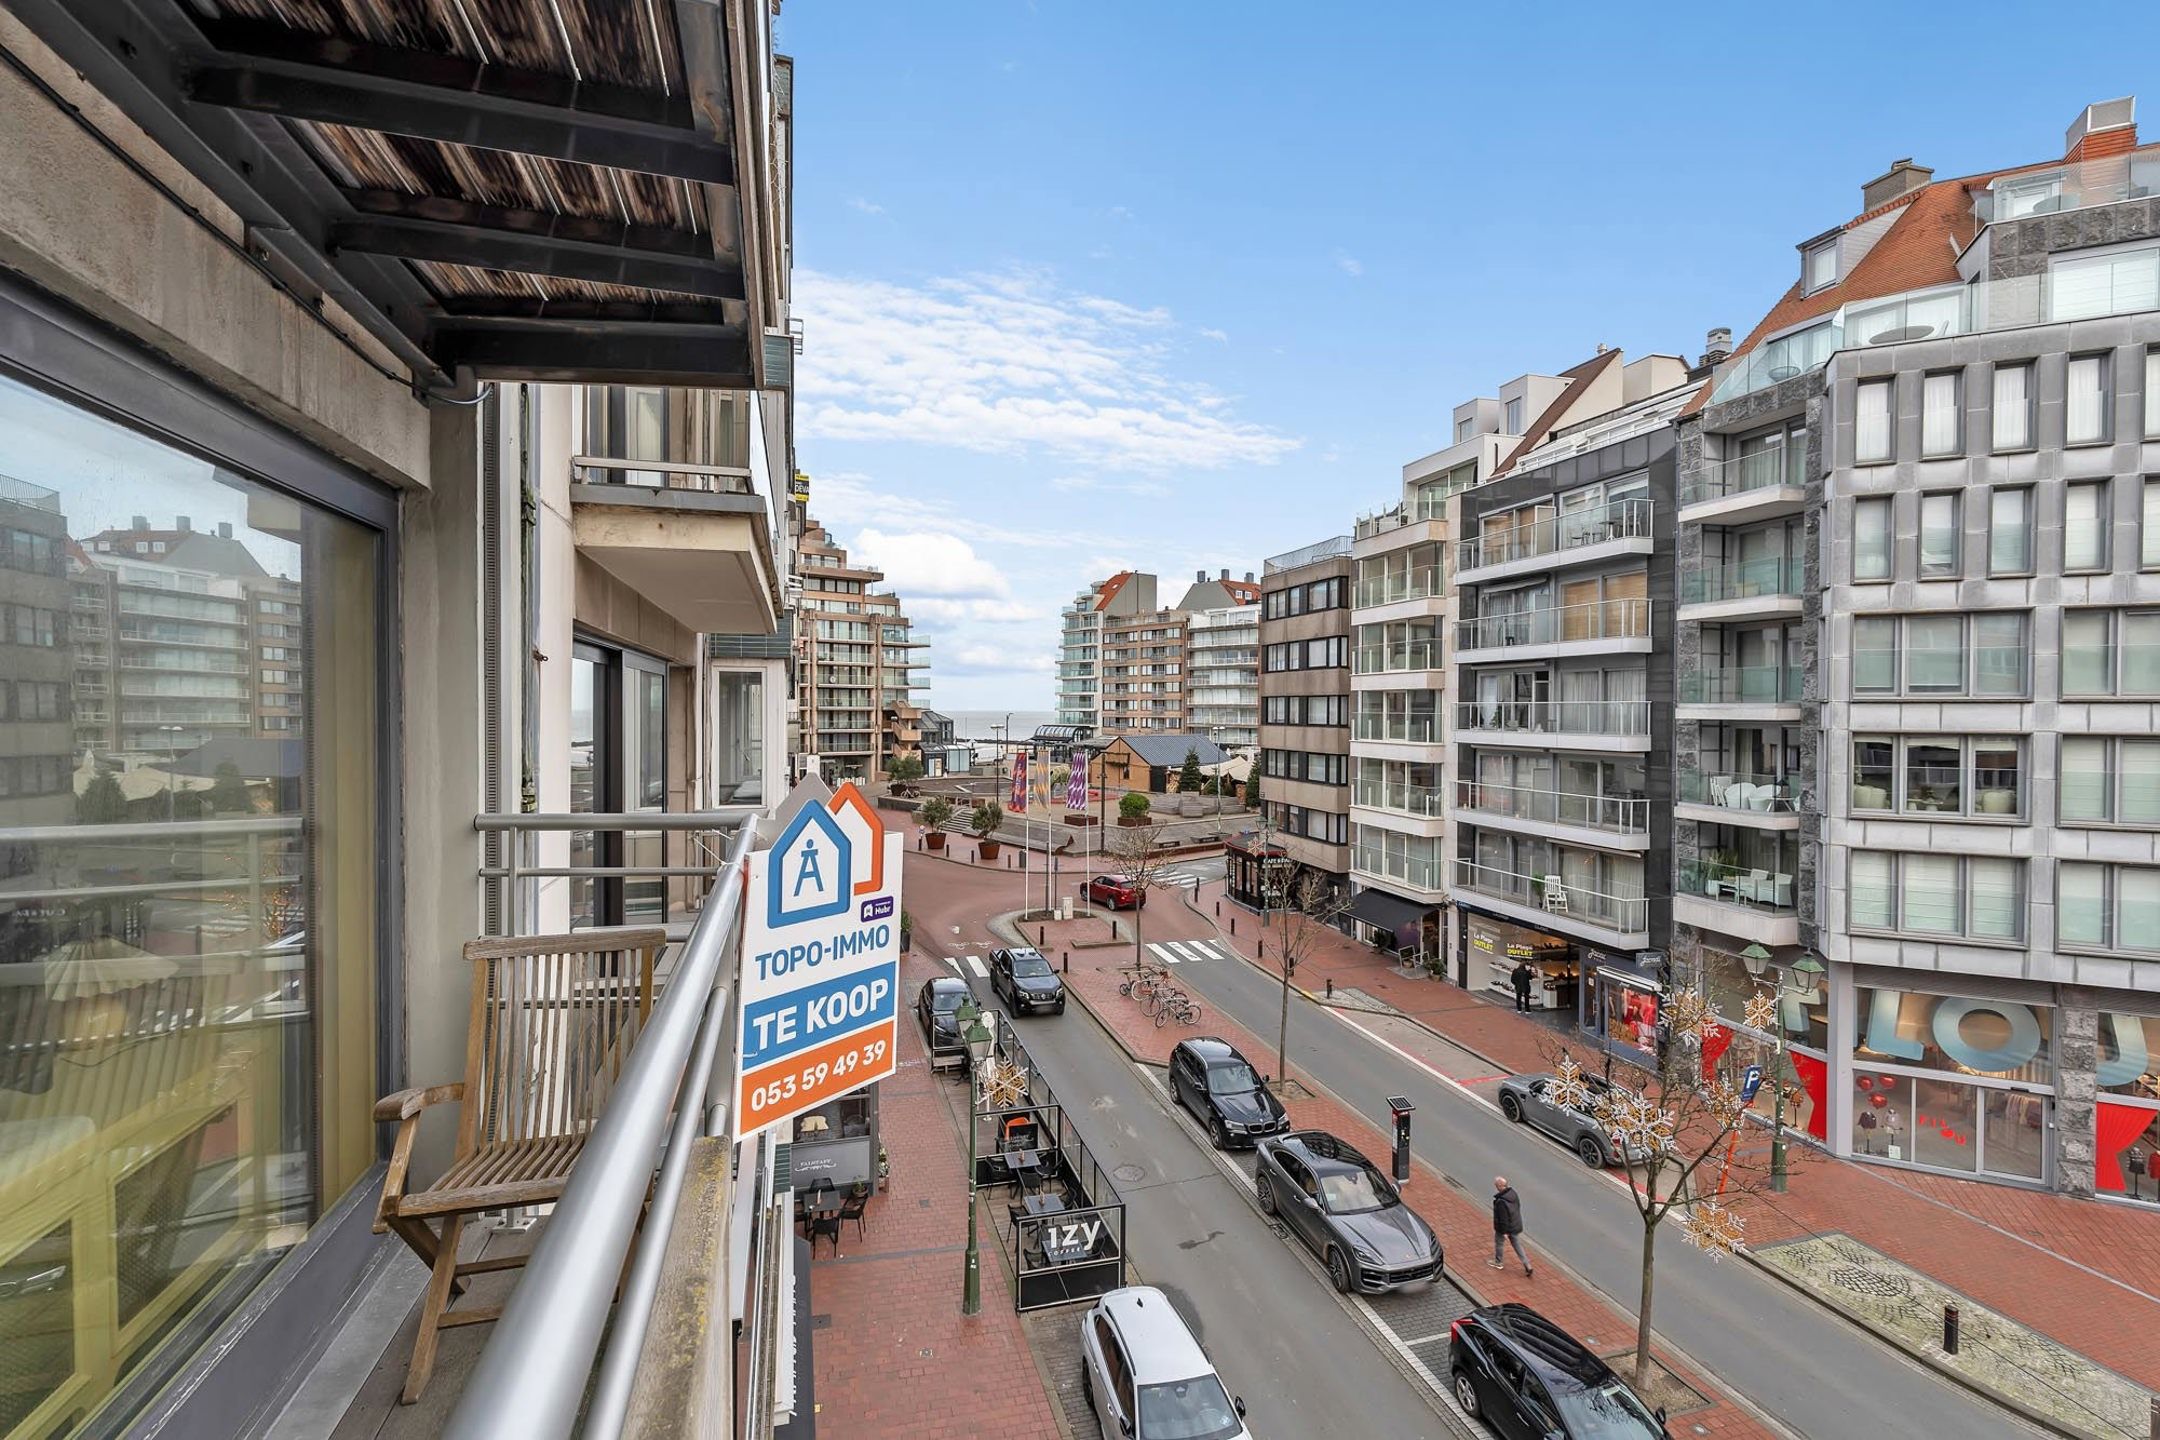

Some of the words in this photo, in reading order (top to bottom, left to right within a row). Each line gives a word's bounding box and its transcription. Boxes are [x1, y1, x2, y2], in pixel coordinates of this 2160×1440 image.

[755, 924, 890, 981] TOPO-IMMO
[1473, 940, 1494, 951] OUTLET
[752, 1005, 798, 1051] TE
[806, 978, 889, 1034] KOOP
[751, 1074, 797, 1112] 053
[801, 1062, 829, 1091] 59
[832, 1050, 859, 1077] 49
[862, 1039, 887, 1066] 39
